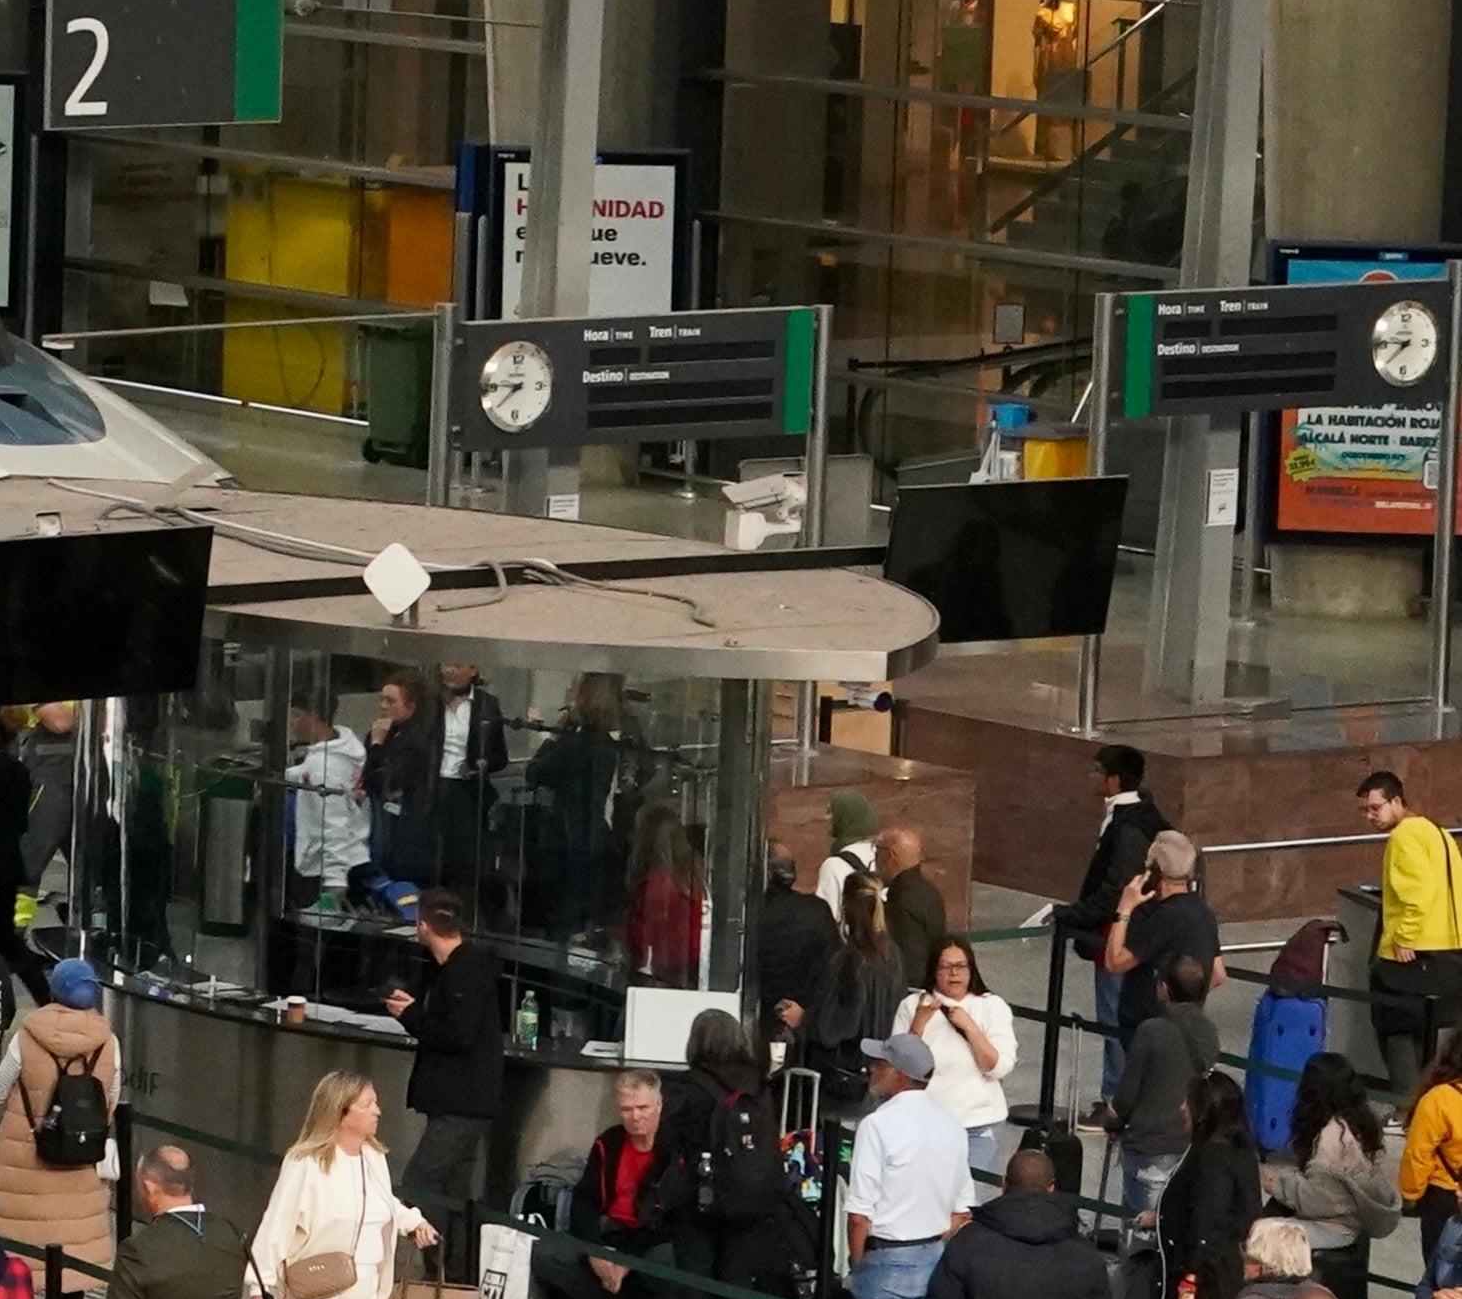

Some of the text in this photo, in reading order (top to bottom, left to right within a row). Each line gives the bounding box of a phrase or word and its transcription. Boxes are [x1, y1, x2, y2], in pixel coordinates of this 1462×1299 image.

[64, 17, 110, 116] 2
[1157, 342, 1196, 355] Destino
[582, 370, 624, 383] Destino
[1307, 414, 1324, 426] LA
[1349, 433, 1389, 446] NORTE
